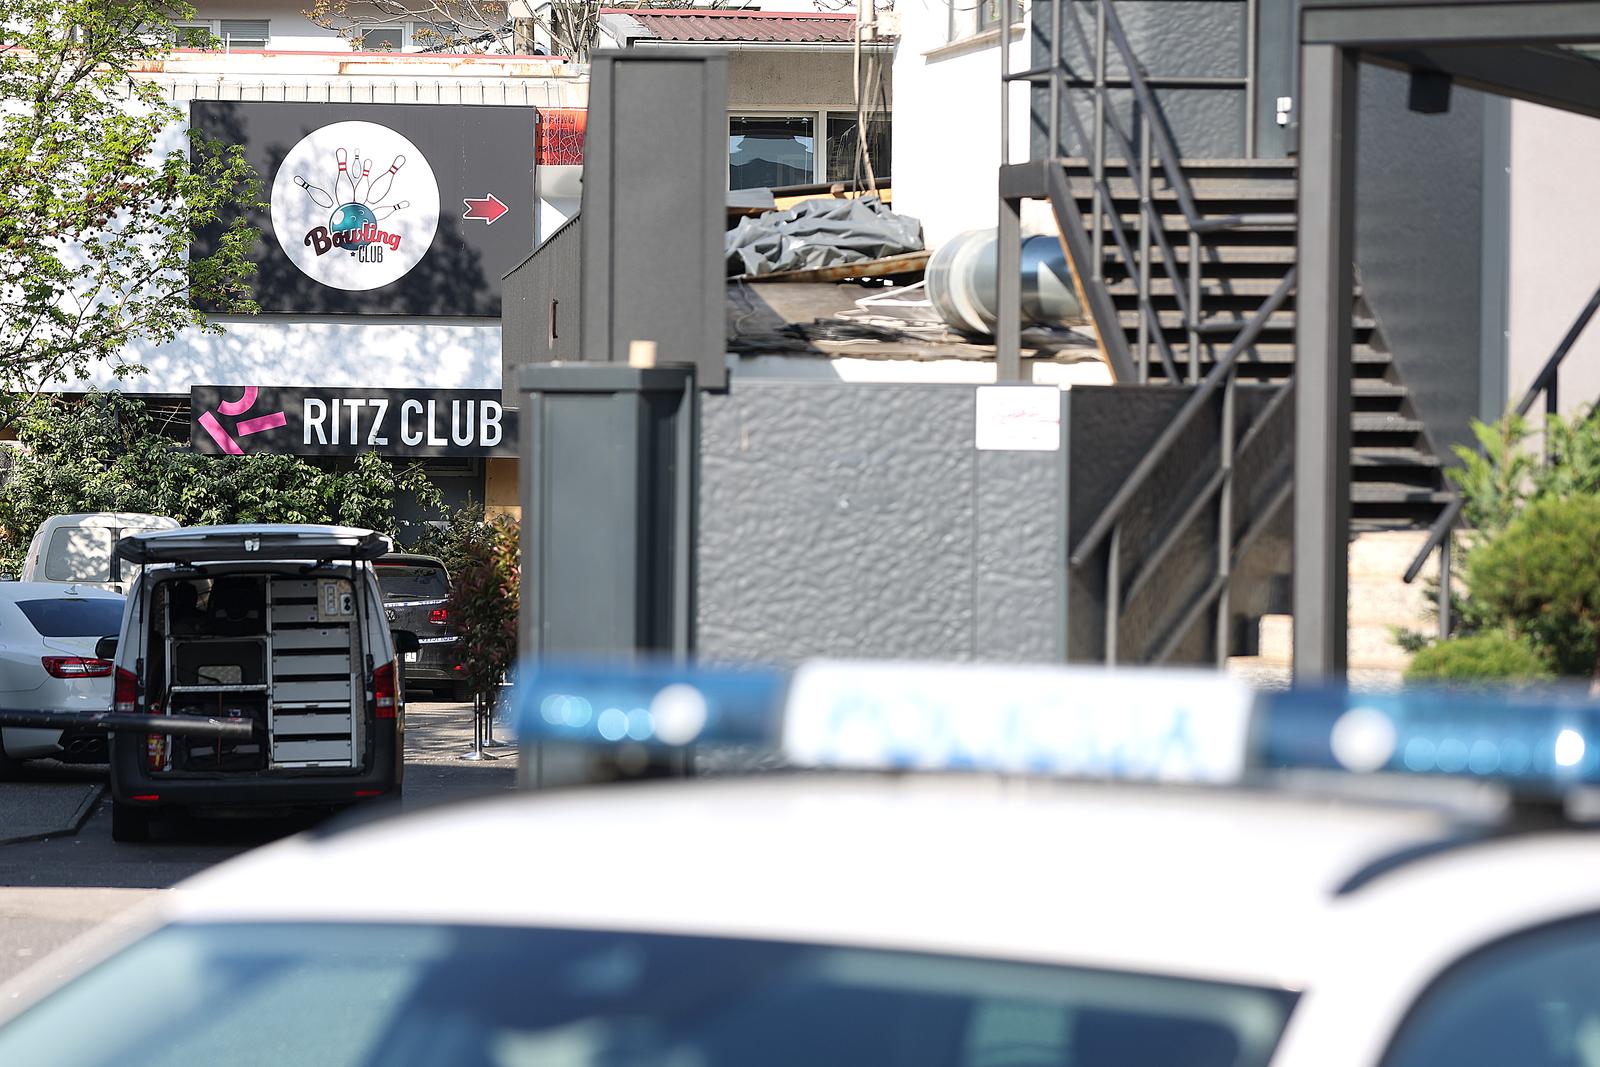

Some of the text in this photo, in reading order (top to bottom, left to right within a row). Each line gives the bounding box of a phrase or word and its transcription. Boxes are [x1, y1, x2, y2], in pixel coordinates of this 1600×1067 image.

[304, 226, 401, 256] Bowling
[358, 245, 383, 263] CLUB
[303, 398, 503, 447] RITZ CLUB
